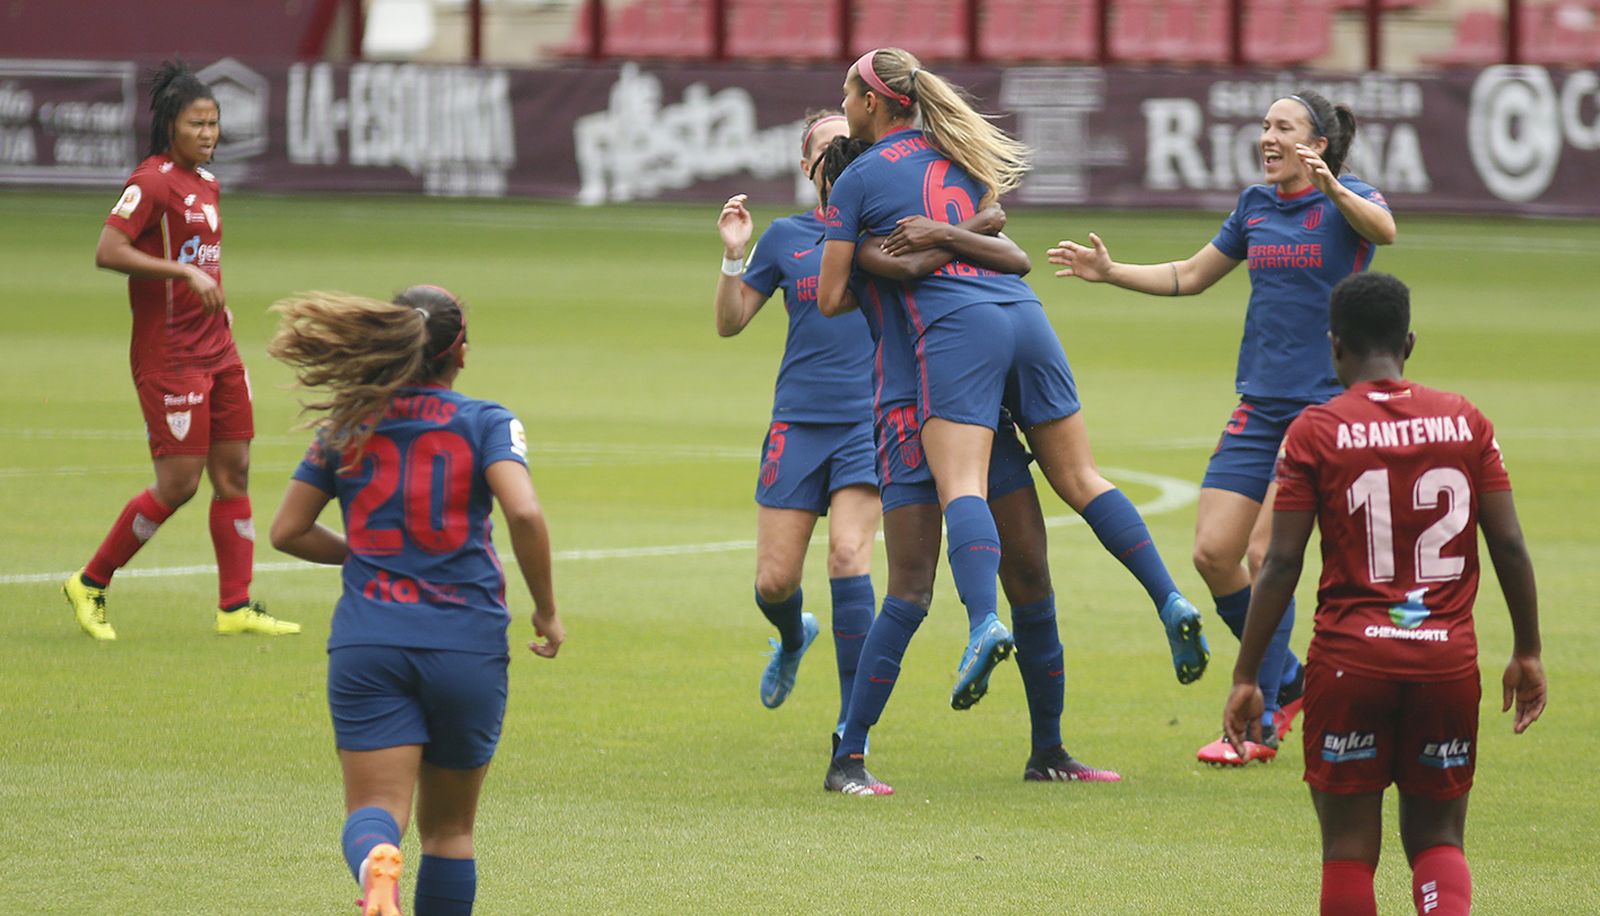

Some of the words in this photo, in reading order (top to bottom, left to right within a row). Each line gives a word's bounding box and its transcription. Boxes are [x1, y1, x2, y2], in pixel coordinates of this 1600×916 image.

[922, 159, 977, 226] 6
[1247, 243, 1322, 257] ERBALIFE
[1247, 255, 1323, 270] UTRITION
[767, 421, 790, 460] 5
[1336, 414, 1474, 449] ASANTEWAA
[339, 429, 474, 556] 20
[1346, 466, 1472, 583] 12
[1364, 625, 1450, 642] CHEMINORTE
